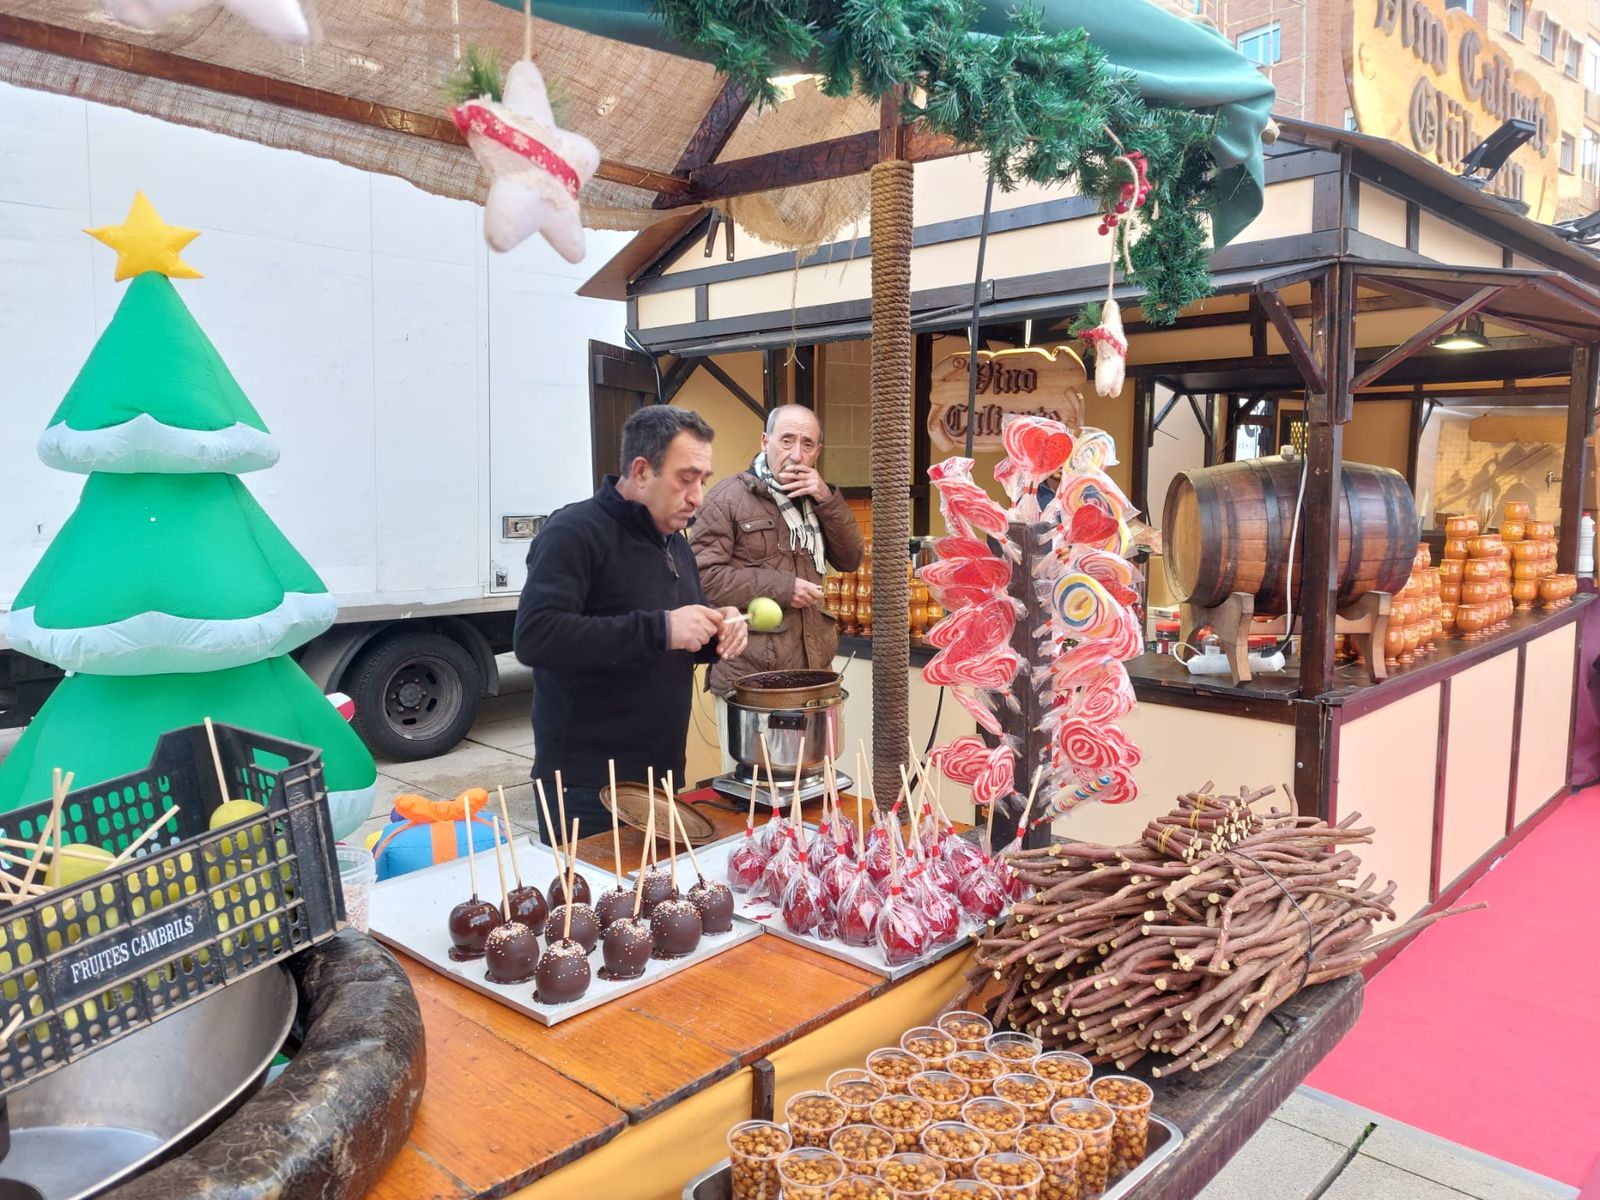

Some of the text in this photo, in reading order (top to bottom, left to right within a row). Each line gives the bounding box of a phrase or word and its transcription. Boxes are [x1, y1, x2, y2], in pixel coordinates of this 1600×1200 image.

[944, 403, 1062, 437] Cali
[70, 915, 194, 984] FRUITES CAMBRILS
